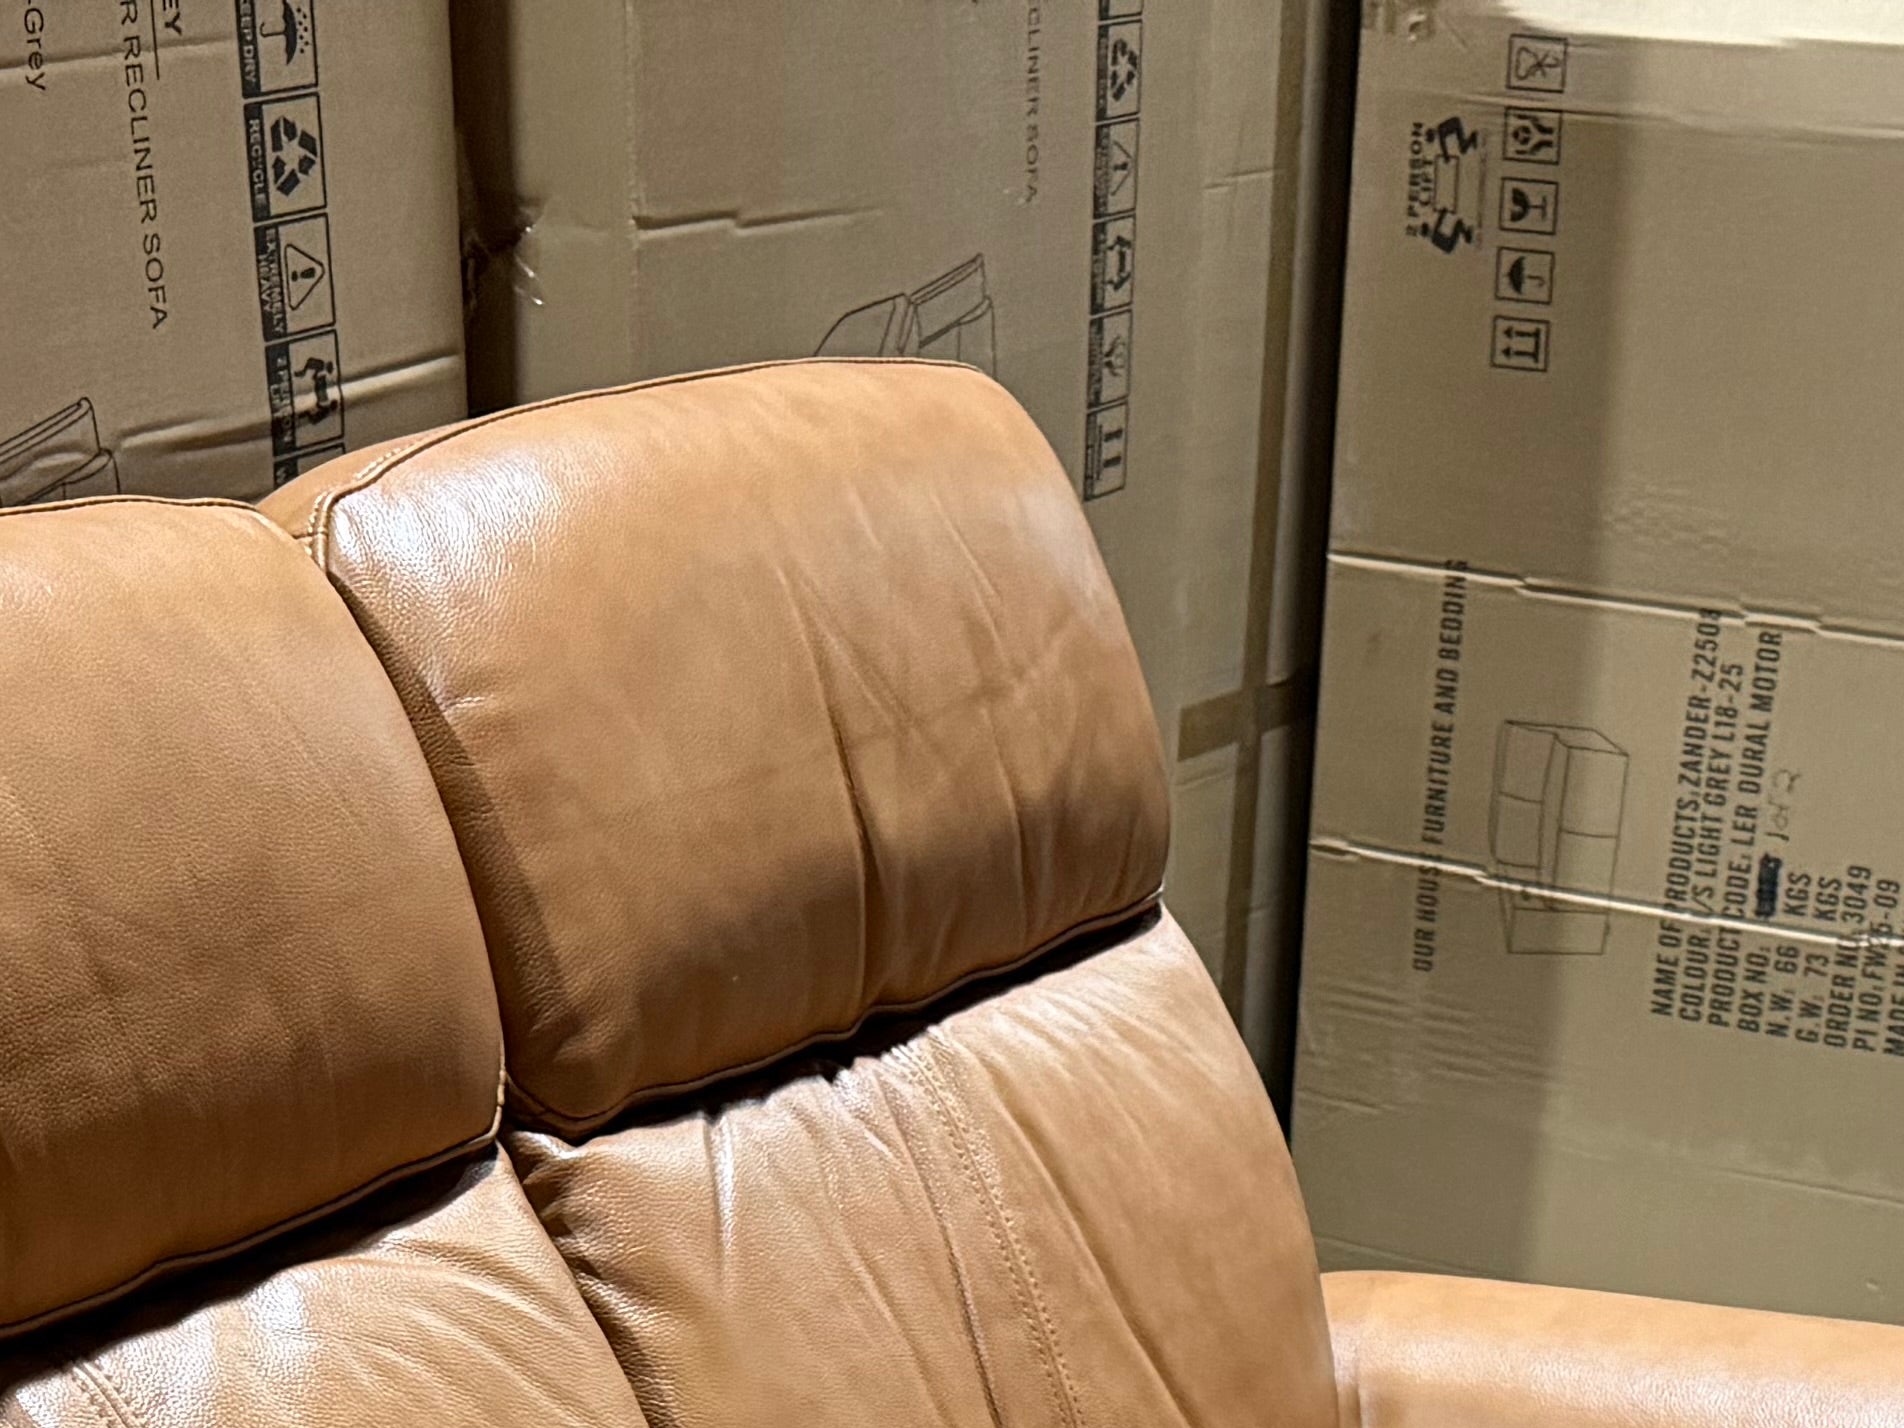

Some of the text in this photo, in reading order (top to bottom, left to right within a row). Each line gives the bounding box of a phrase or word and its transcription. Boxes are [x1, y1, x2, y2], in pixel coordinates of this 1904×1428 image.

[238, 0, 257, 83] EEP DRY
[122, 35, 158, 225] RECLINER
[142, 233, 168, 330] SOFA
[1433, 669, 1461, 717] AND
[1711, 663, 1744, 743] L18-25
[1422, 723, 1455, 846] FURNITURE
[1702, 749, 1733, 808] GREY
[1695, 812, 1724, 877] LIGHT
[1707, 630, 1783, 1028] PRODUCT CODE: LER DURAL MOTOR
[1783, 872, 1812, 917] KGS
[1412, 928, 1436, 973] OUR
[1659, 919, 1682, 947] OF
[1774, 945, 1800, 973] 66
[1794, 876, 1843, 1043] G.W: 73 KGS
[1651, 955, 1679, 1016] NAME
[1746, 946, 1772, 984] NO:
[1737, 988, 1764, 1033] BOX
[1823, 976, 1855, 1048] ORDER
[1852, 1032, 1879, 1052] PI
